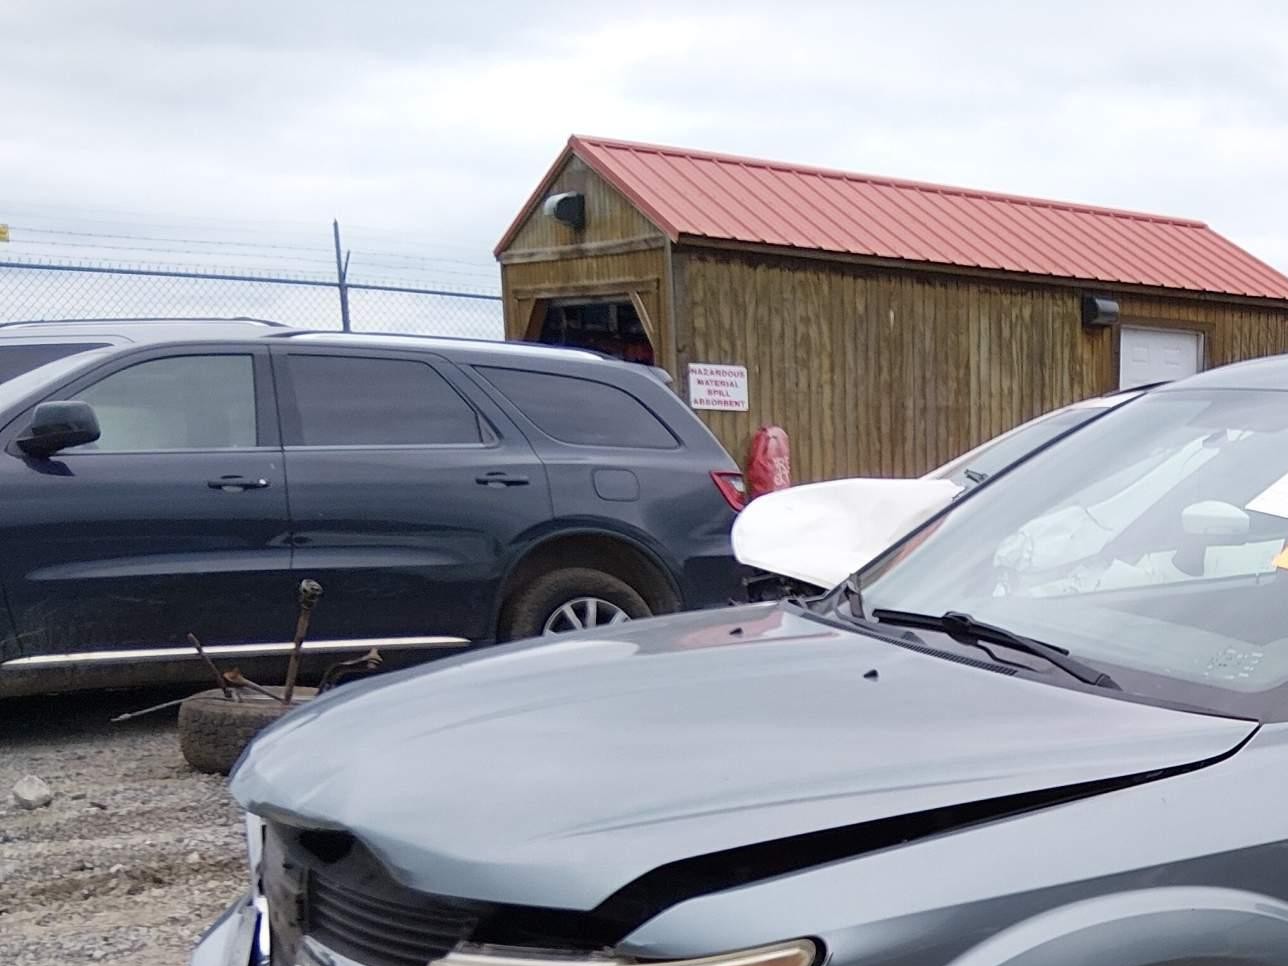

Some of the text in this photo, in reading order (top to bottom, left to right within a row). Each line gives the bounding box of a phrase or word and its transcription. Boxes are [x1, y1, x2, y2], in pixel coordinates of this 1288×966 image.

[690, 367, 746, 379] HAZARDOUS
[697, 378, 739, 389] MATERIAL
[706, 388, 731, 398] SPILL
[693, 397, 746, 408] ABSORBENT
